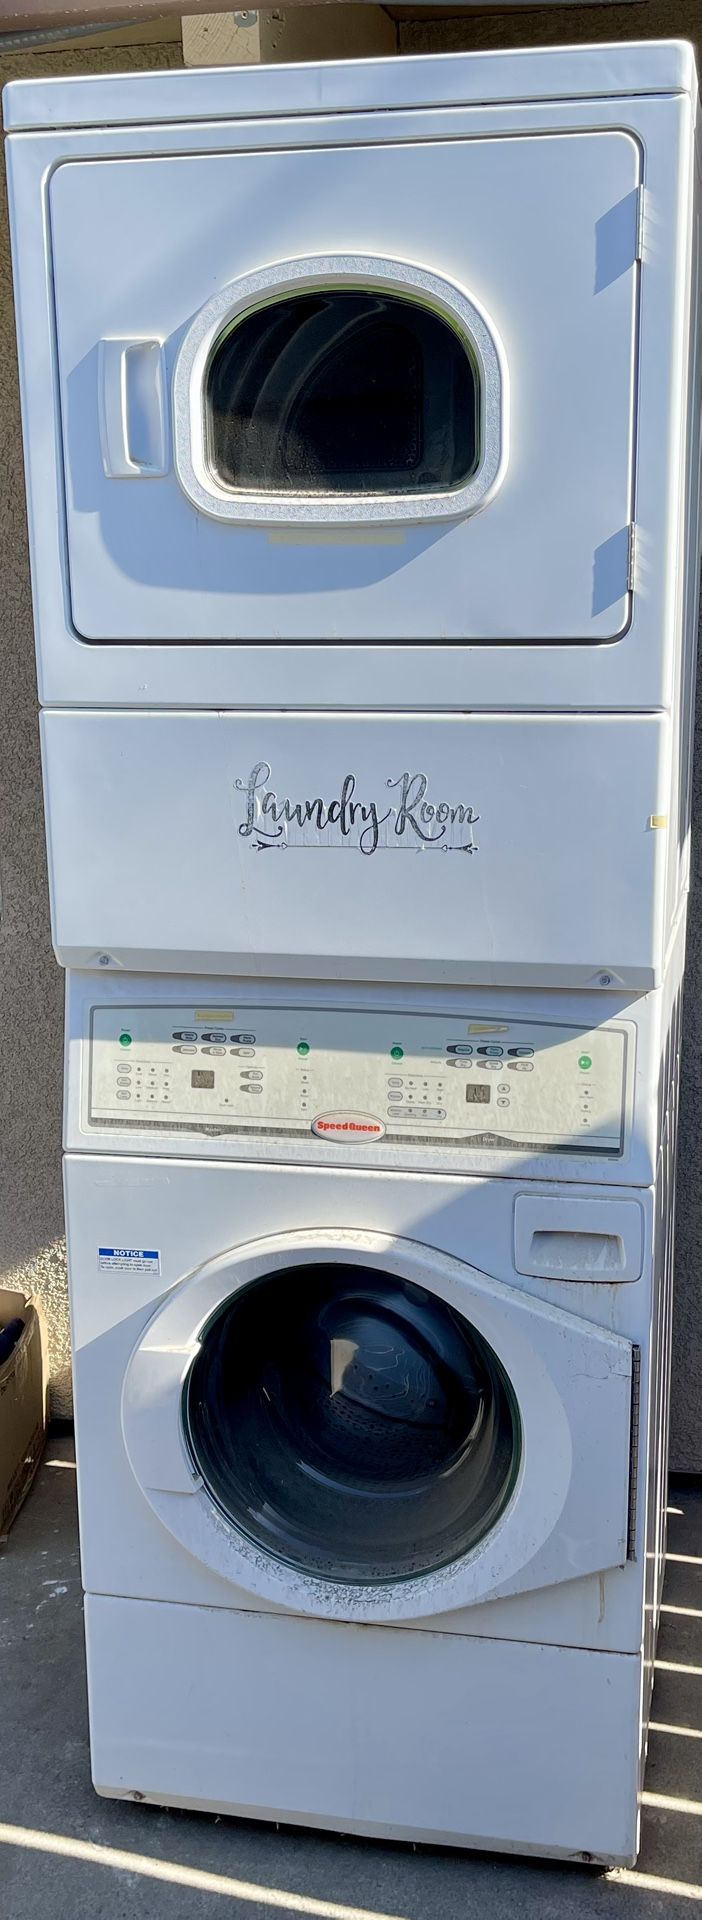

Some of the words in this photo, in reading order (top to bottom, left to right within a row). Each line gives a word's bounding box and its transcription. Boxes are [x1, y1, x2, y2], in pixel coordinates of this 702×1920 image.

[233, 761, 391, 856] Laundry
[385, 772, 479, 841] Room
[317, 1121, 348, 1131] Speed
[349, 1122, 381, 1132] Queen
[113, 1249, 144, 1257] NOTICE
